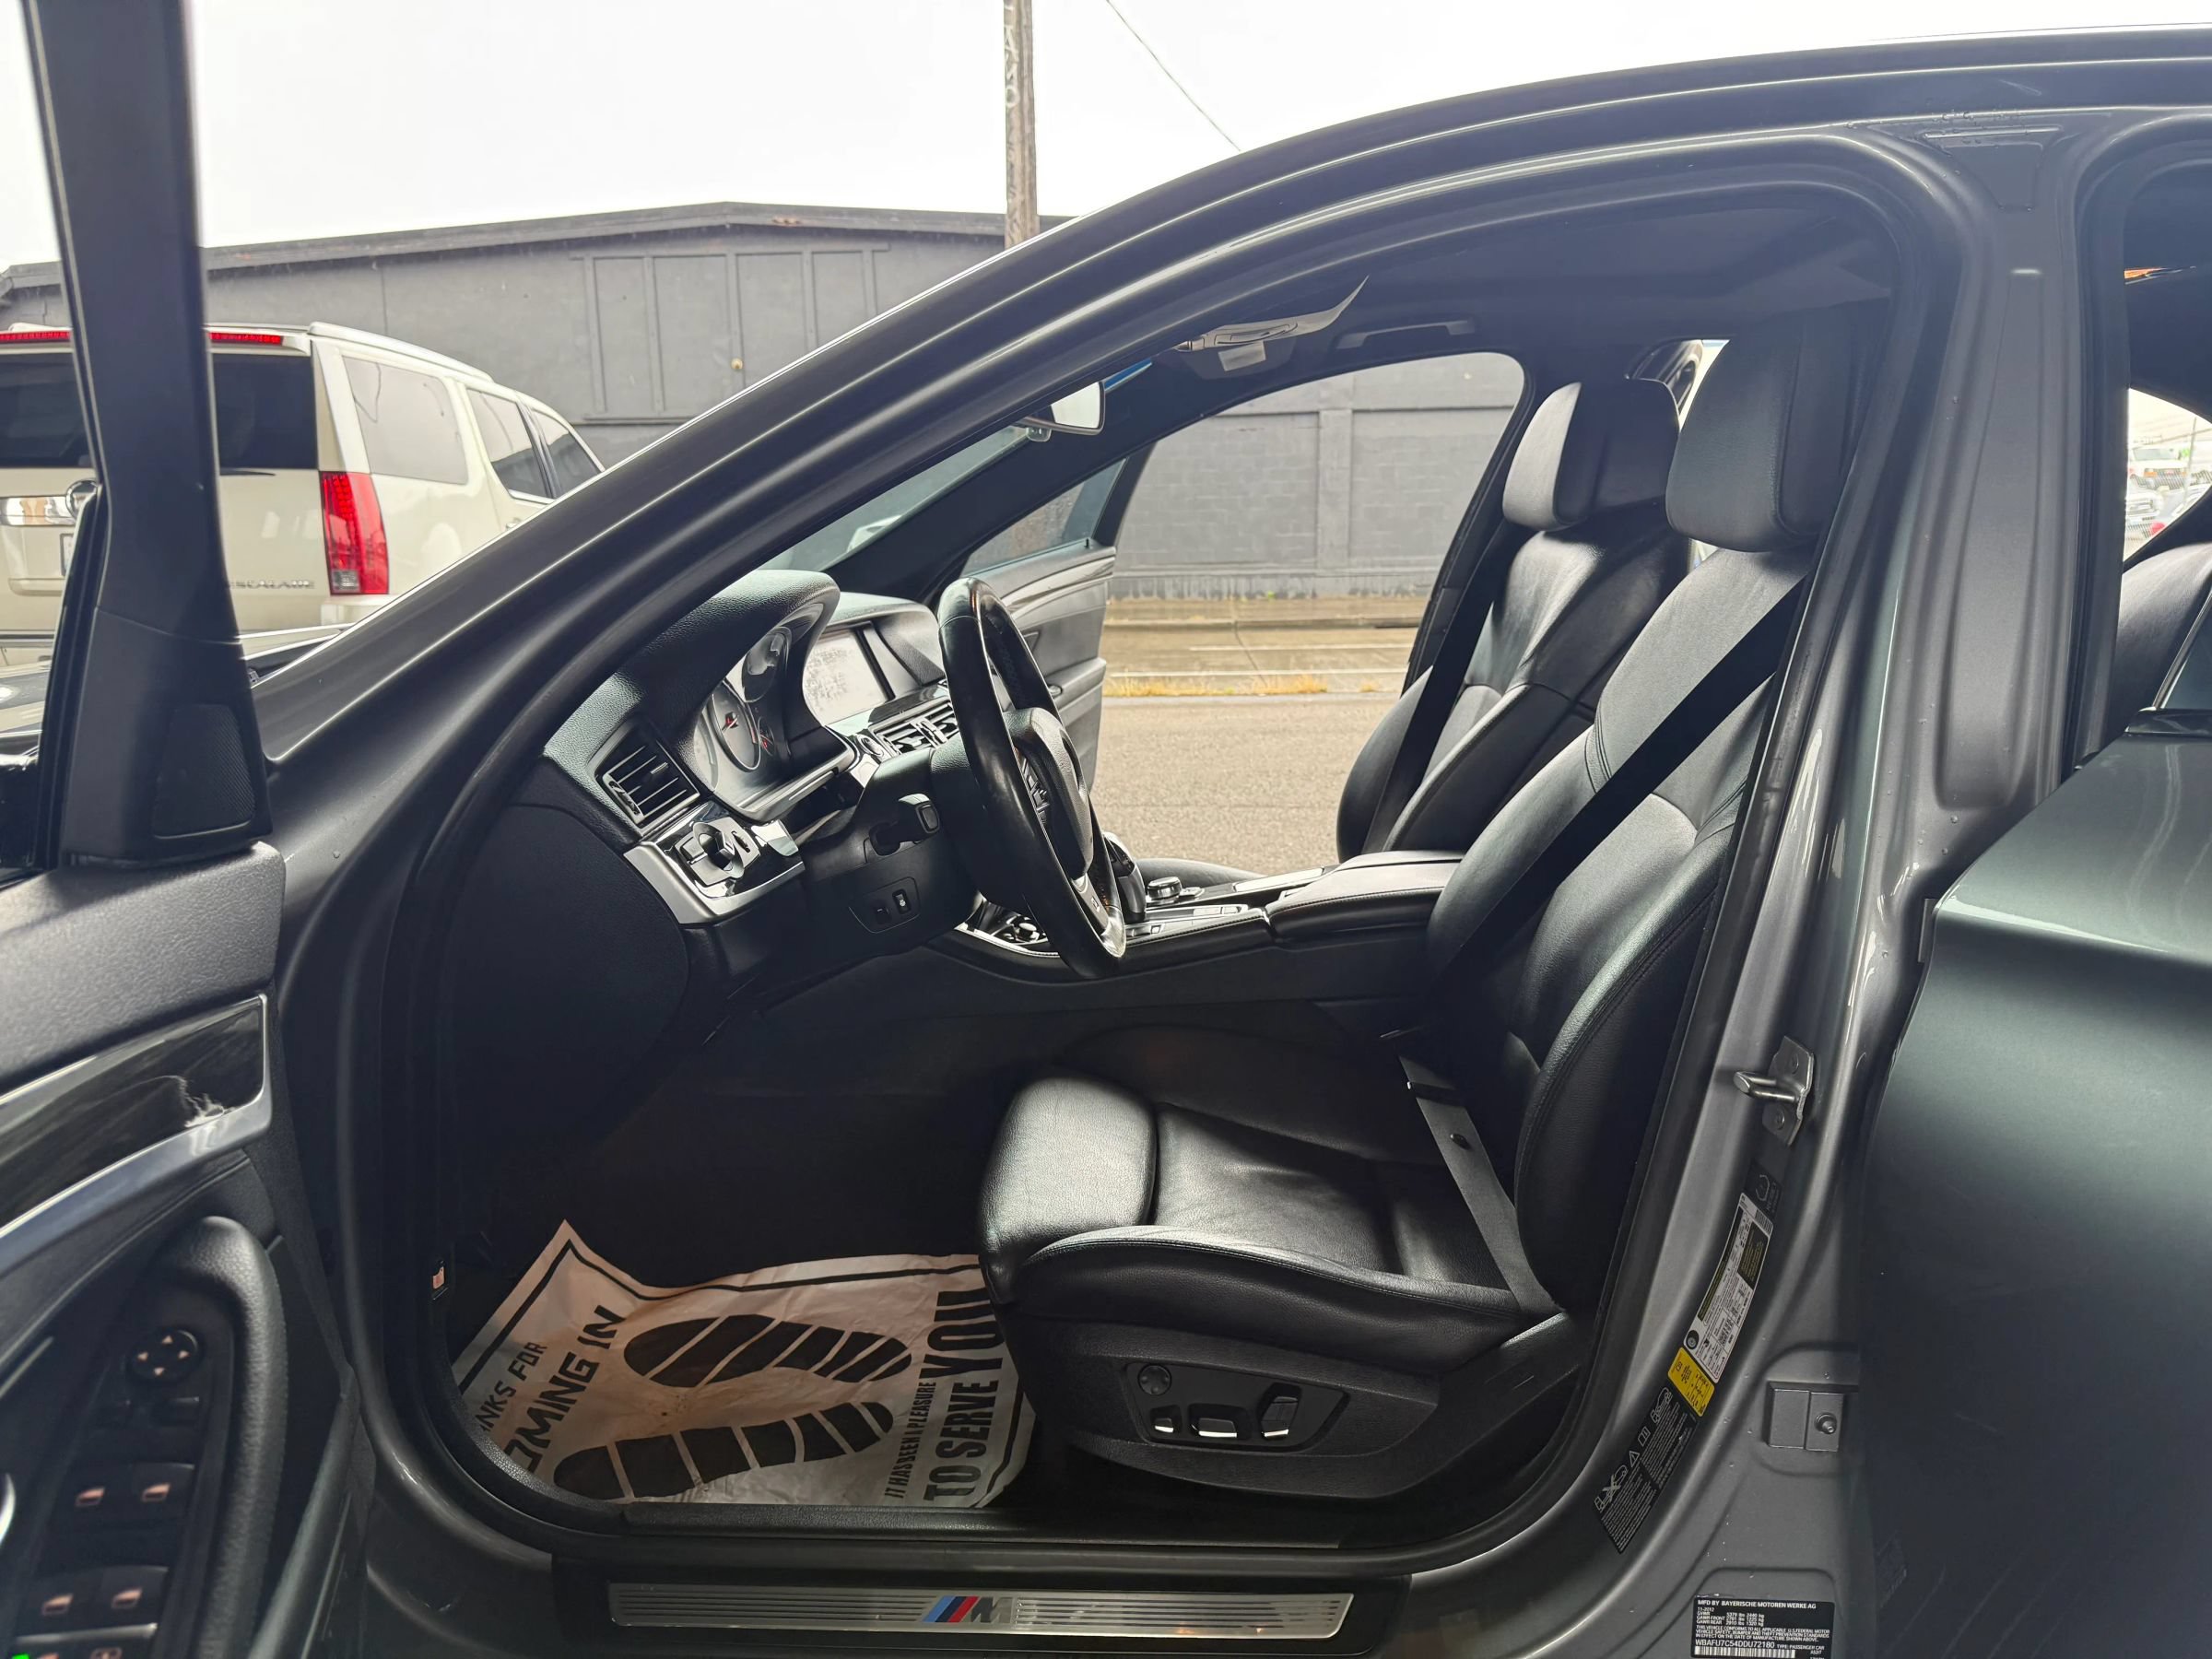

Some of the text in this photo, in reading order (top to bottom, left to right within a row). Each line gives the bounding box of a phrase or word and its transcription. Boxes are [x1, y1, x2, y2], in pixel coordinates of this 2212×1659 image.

[475, 1342, 547, 1431] NKS FOR
[503, 1304, 627, 1474] OMING IN
[919, 1288, 1006, 1501] TO SERVE YOU
[906, 1382, 936, 1428] PLEASURE
[896, 1437, 921, 1464] BEEN
[884, 1487, 906, 1499] IT
[888, 1464, 913, 1486] HAS
[1695, 1639, 1775, 1649] WBAFU7C54DDU72180
